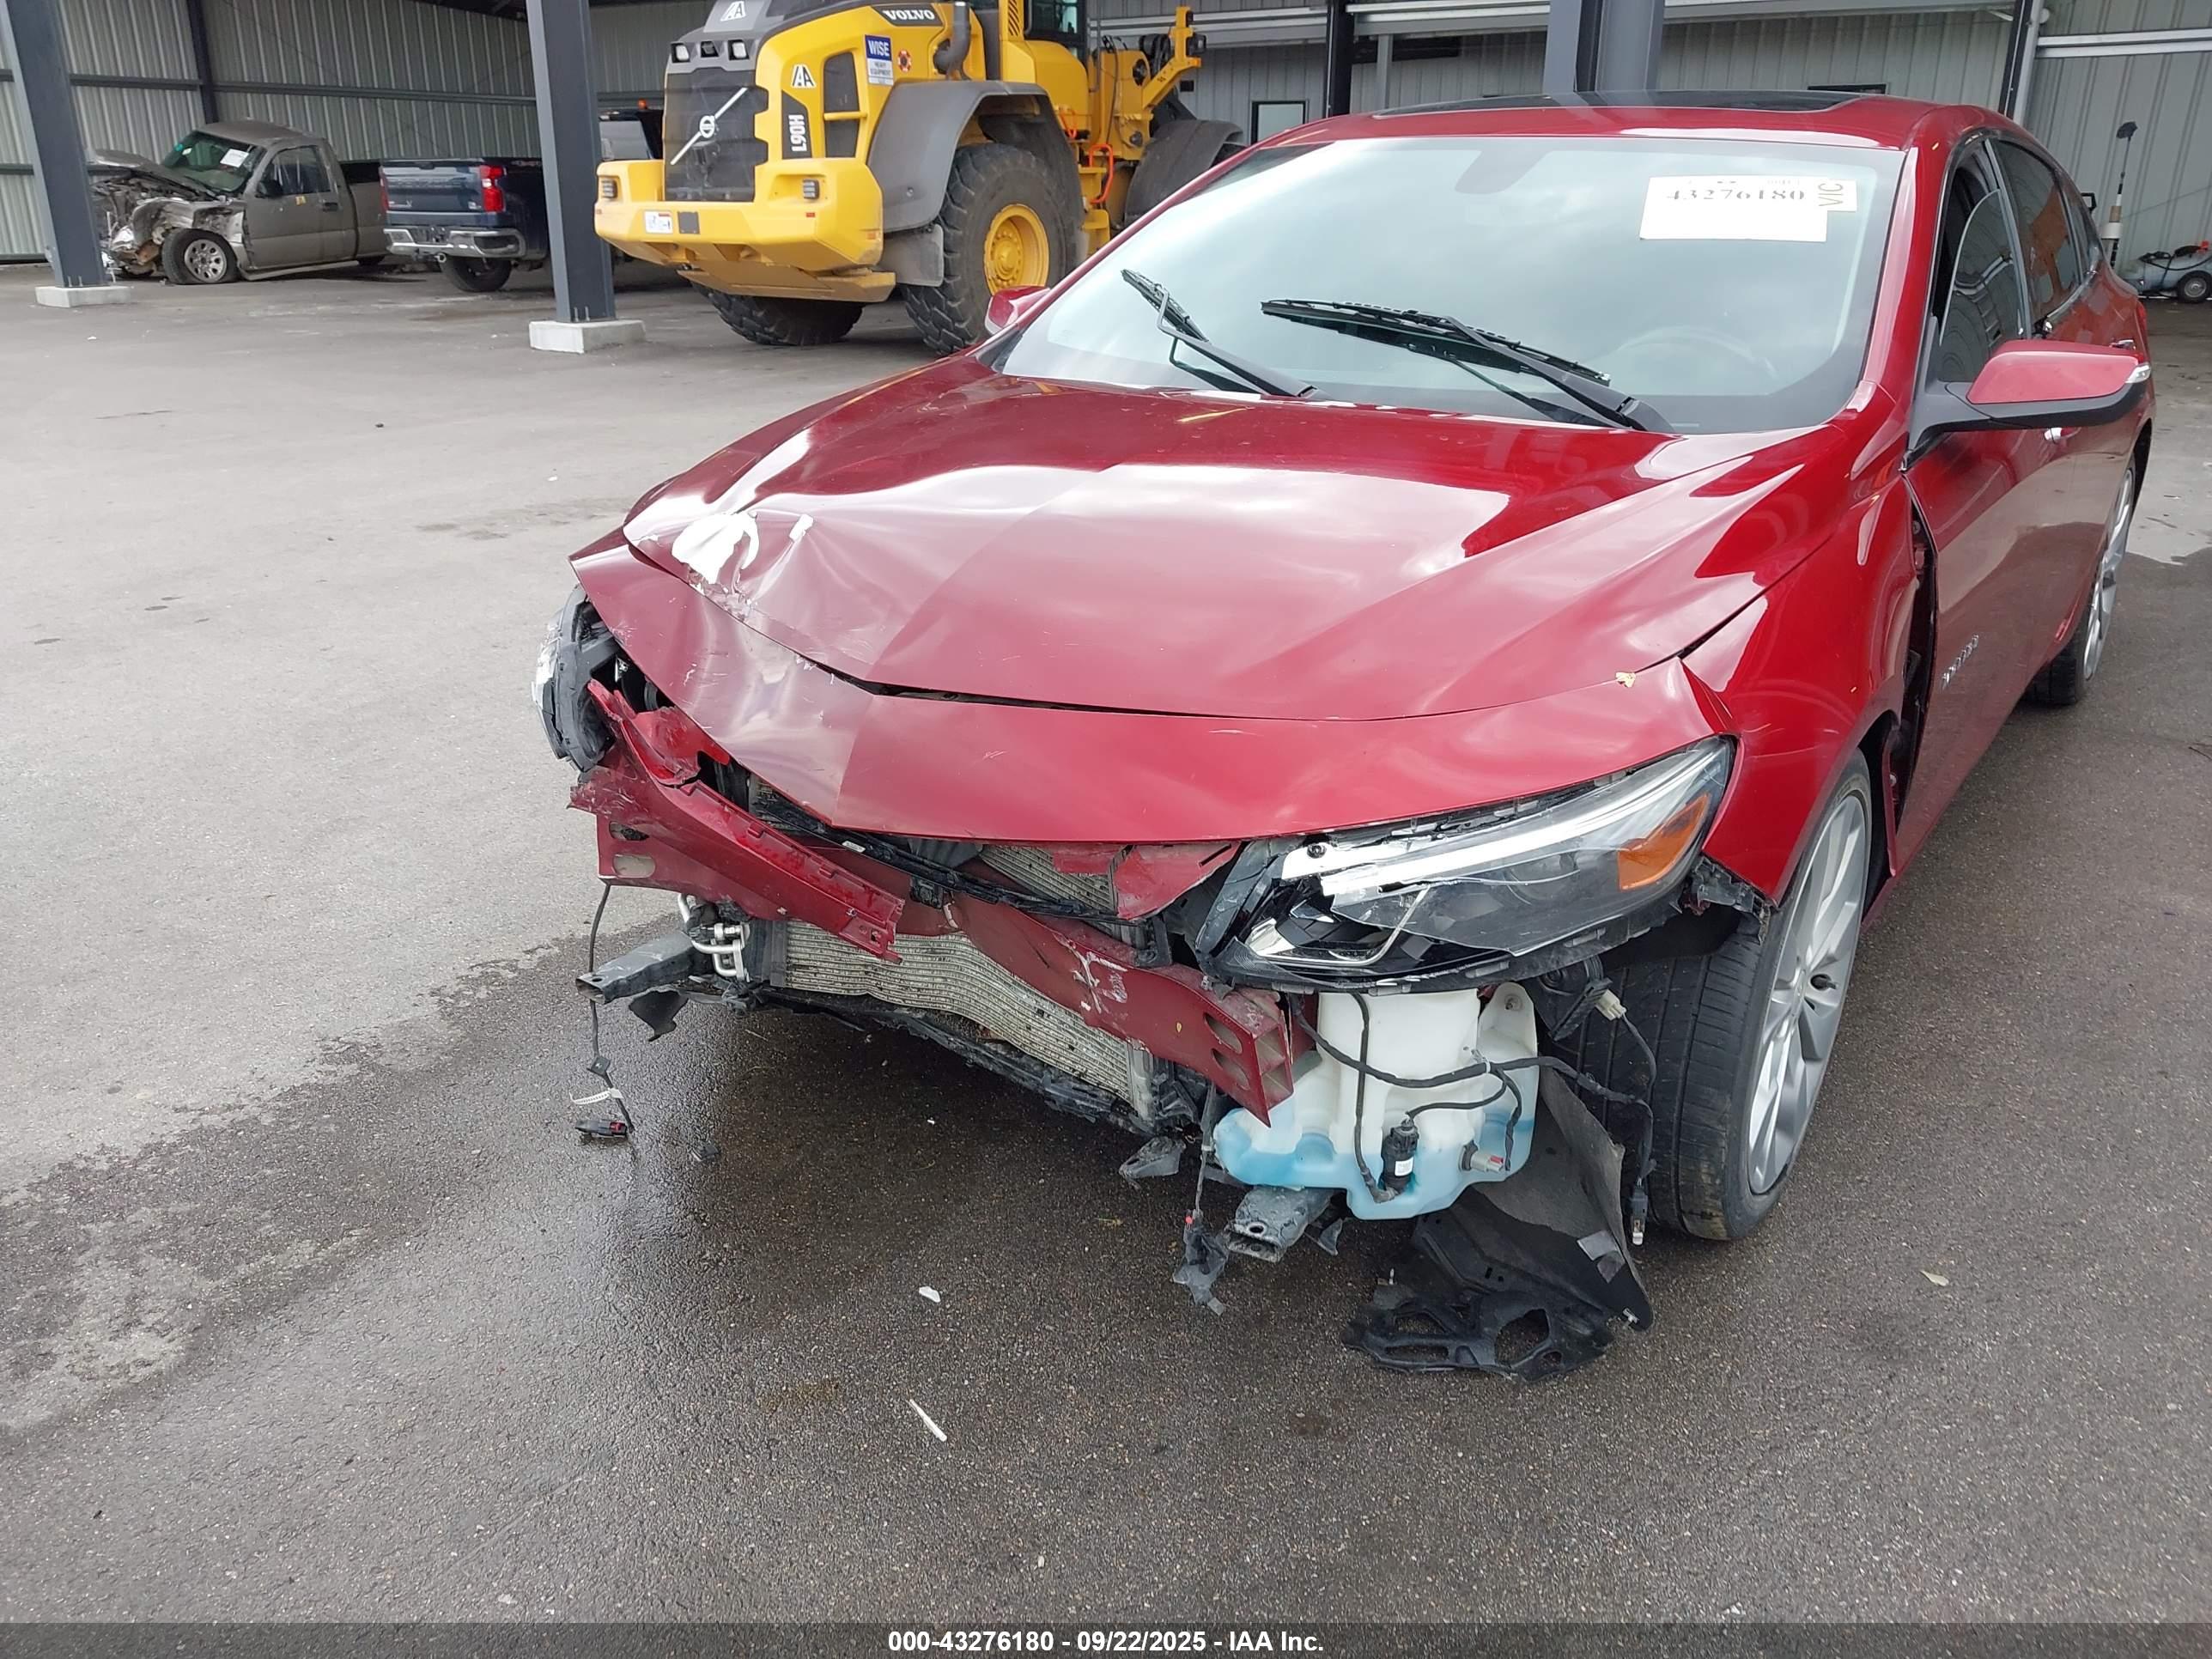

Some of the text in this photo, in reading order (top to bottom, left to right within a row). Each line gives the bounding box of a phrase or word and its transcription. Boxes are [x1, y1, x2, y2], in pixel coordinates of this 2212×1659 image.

[882, 9, 935, 21] VOLVO
[867, 40, 890, 58] WISE
[788, 114, 807, 152] L90H
[1818, 183, 1844, 207] VIC
